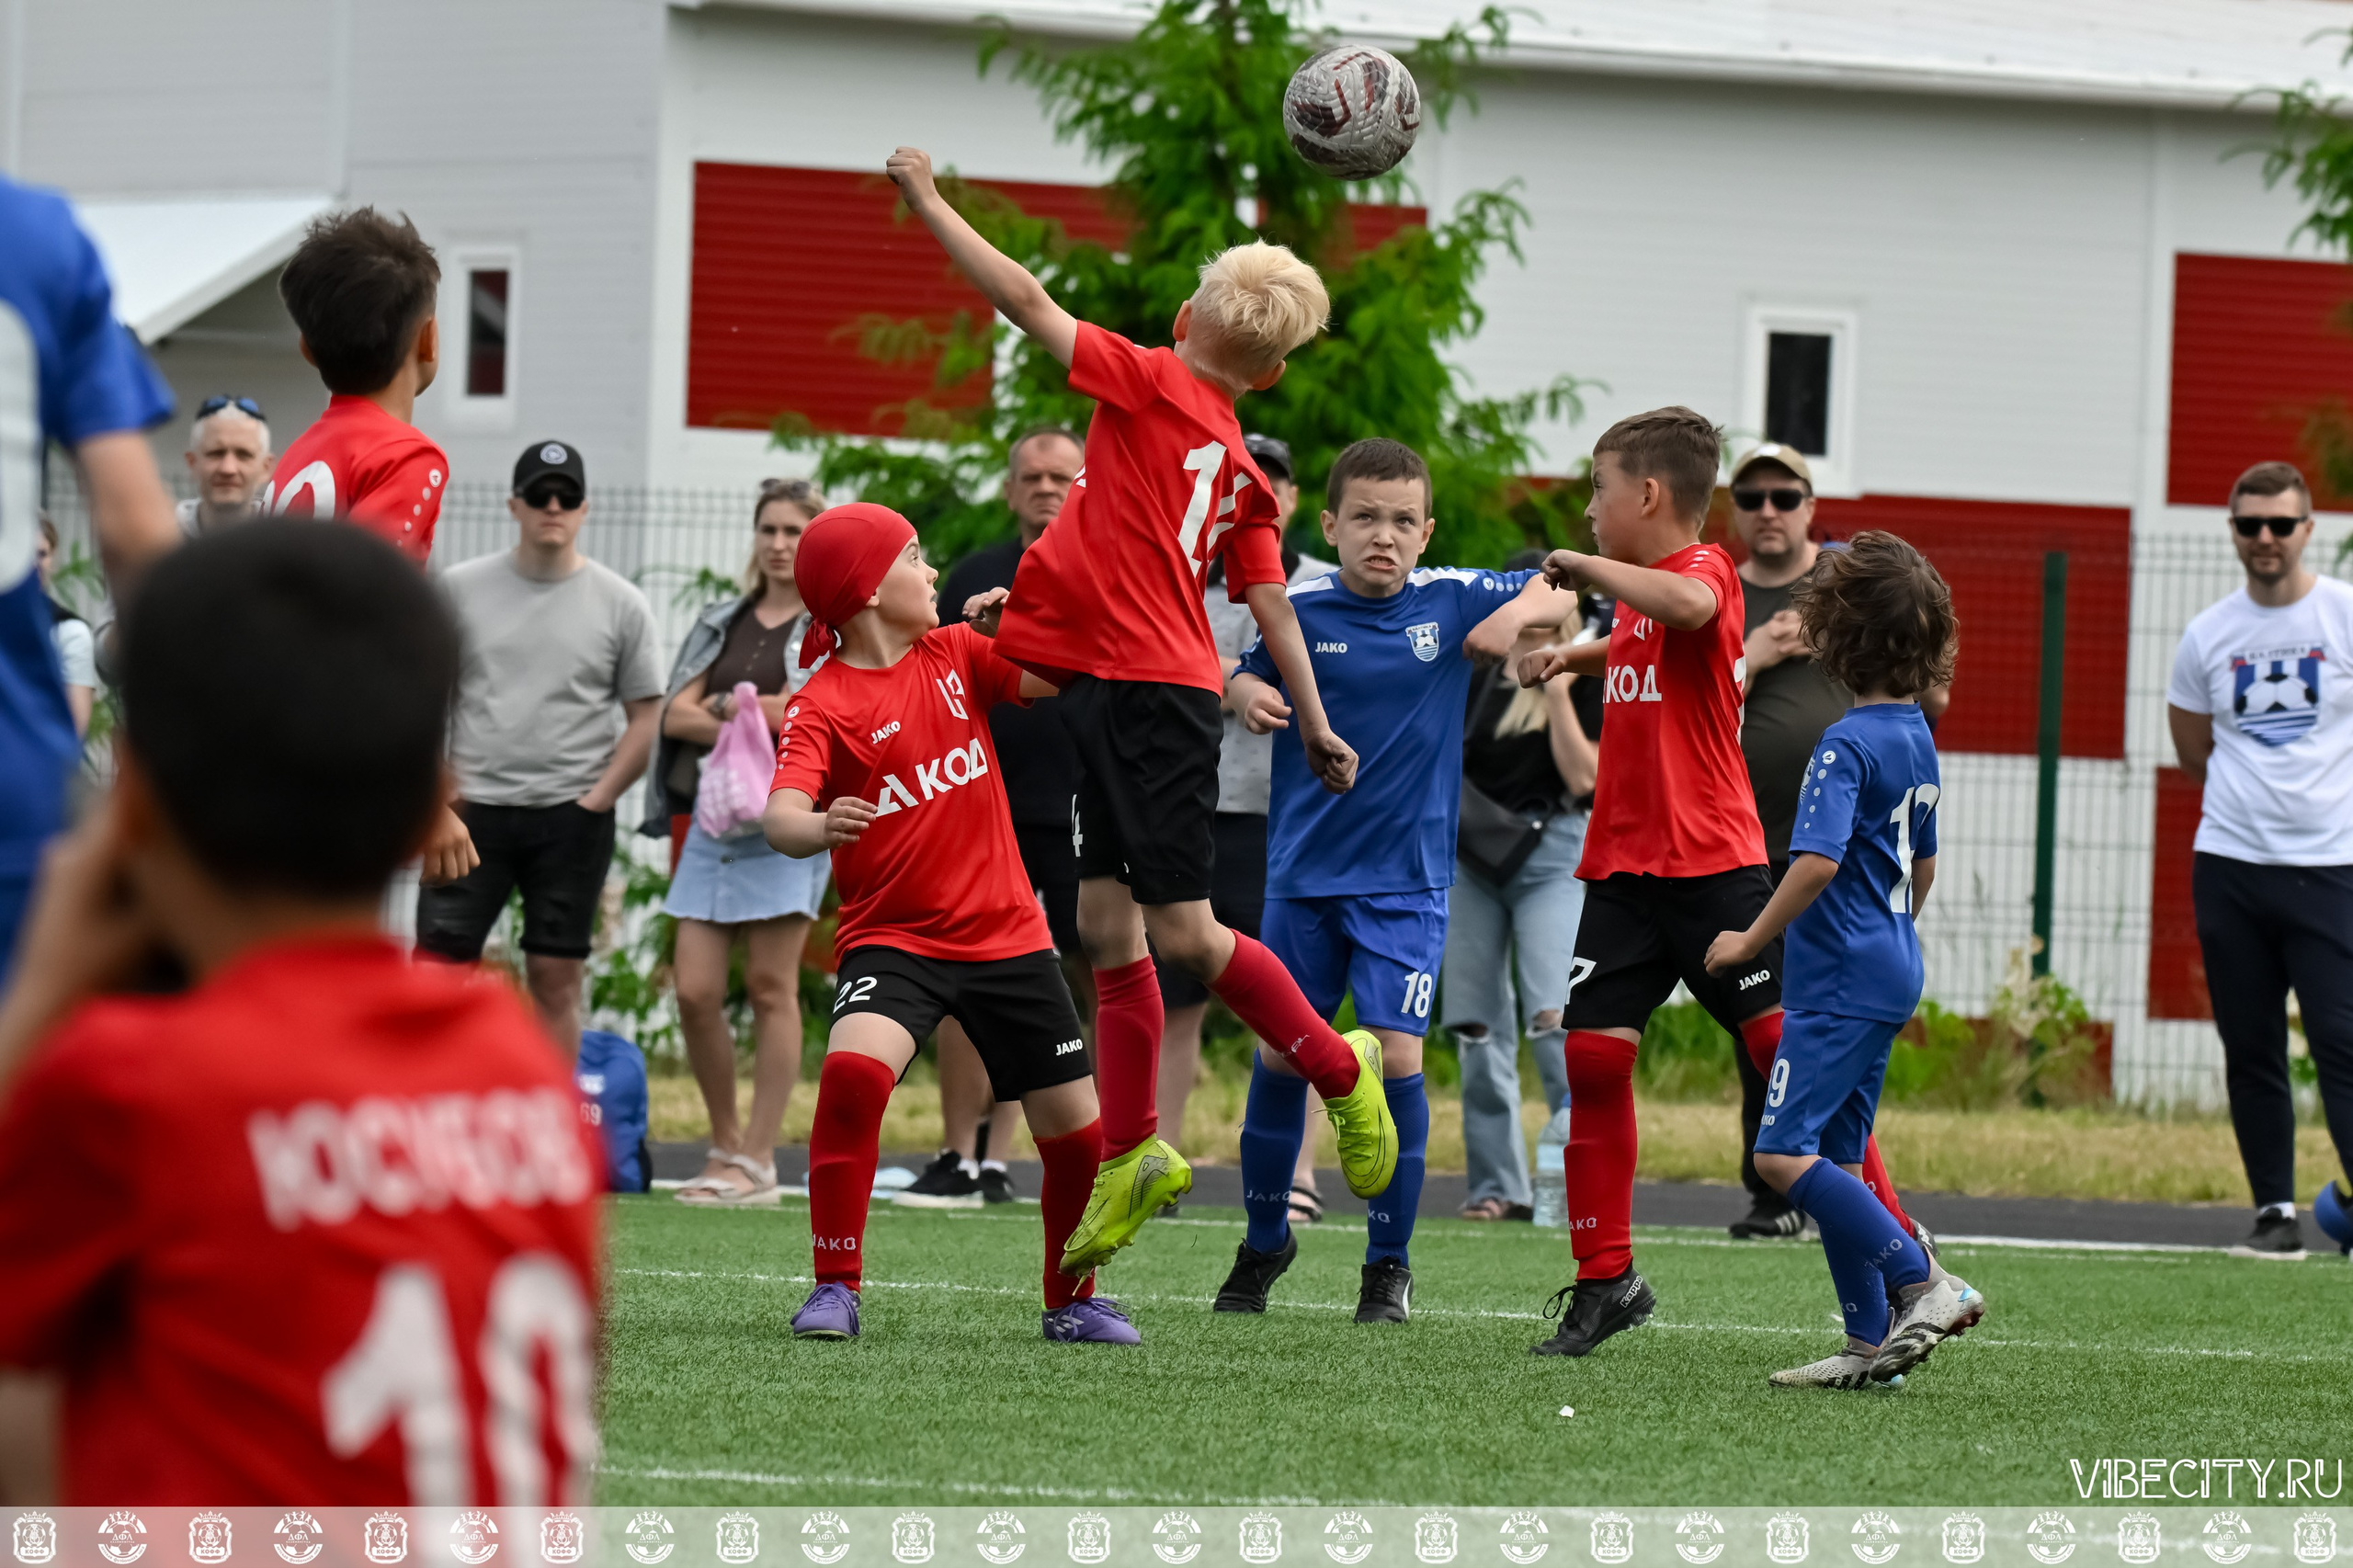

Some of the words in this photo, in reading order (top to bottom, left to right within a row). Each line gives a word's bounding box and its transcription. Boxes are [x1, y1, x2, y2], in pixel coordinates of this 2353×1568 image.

[1315, 642, 1348, 653] JAKO
[1603, 665, 1663, 703] КОД
[870, 721, 901, 744] JAKO
[1565, 956, 1597, 1006] 7
[1738, 969, 1771, 991] JAKO
[833, 976, 878, 1014] 22
[1401, 971, 1433, 1018] 18
[1055, 1038, 1083, 1056] JAKO
[1766, 1058, 1790, 1108] 9
[1761, 1114, 1776, 1127] KO
[1246, 1189, 1292, 1202] JAKO
[1368, 1209, 1391, 1223] KO
[1569, 1217, 1597, 1232] AKO
[1864, 1238, 1903, 1269] JAKO
[1620, 1275, 1643, 1308] Kappa
